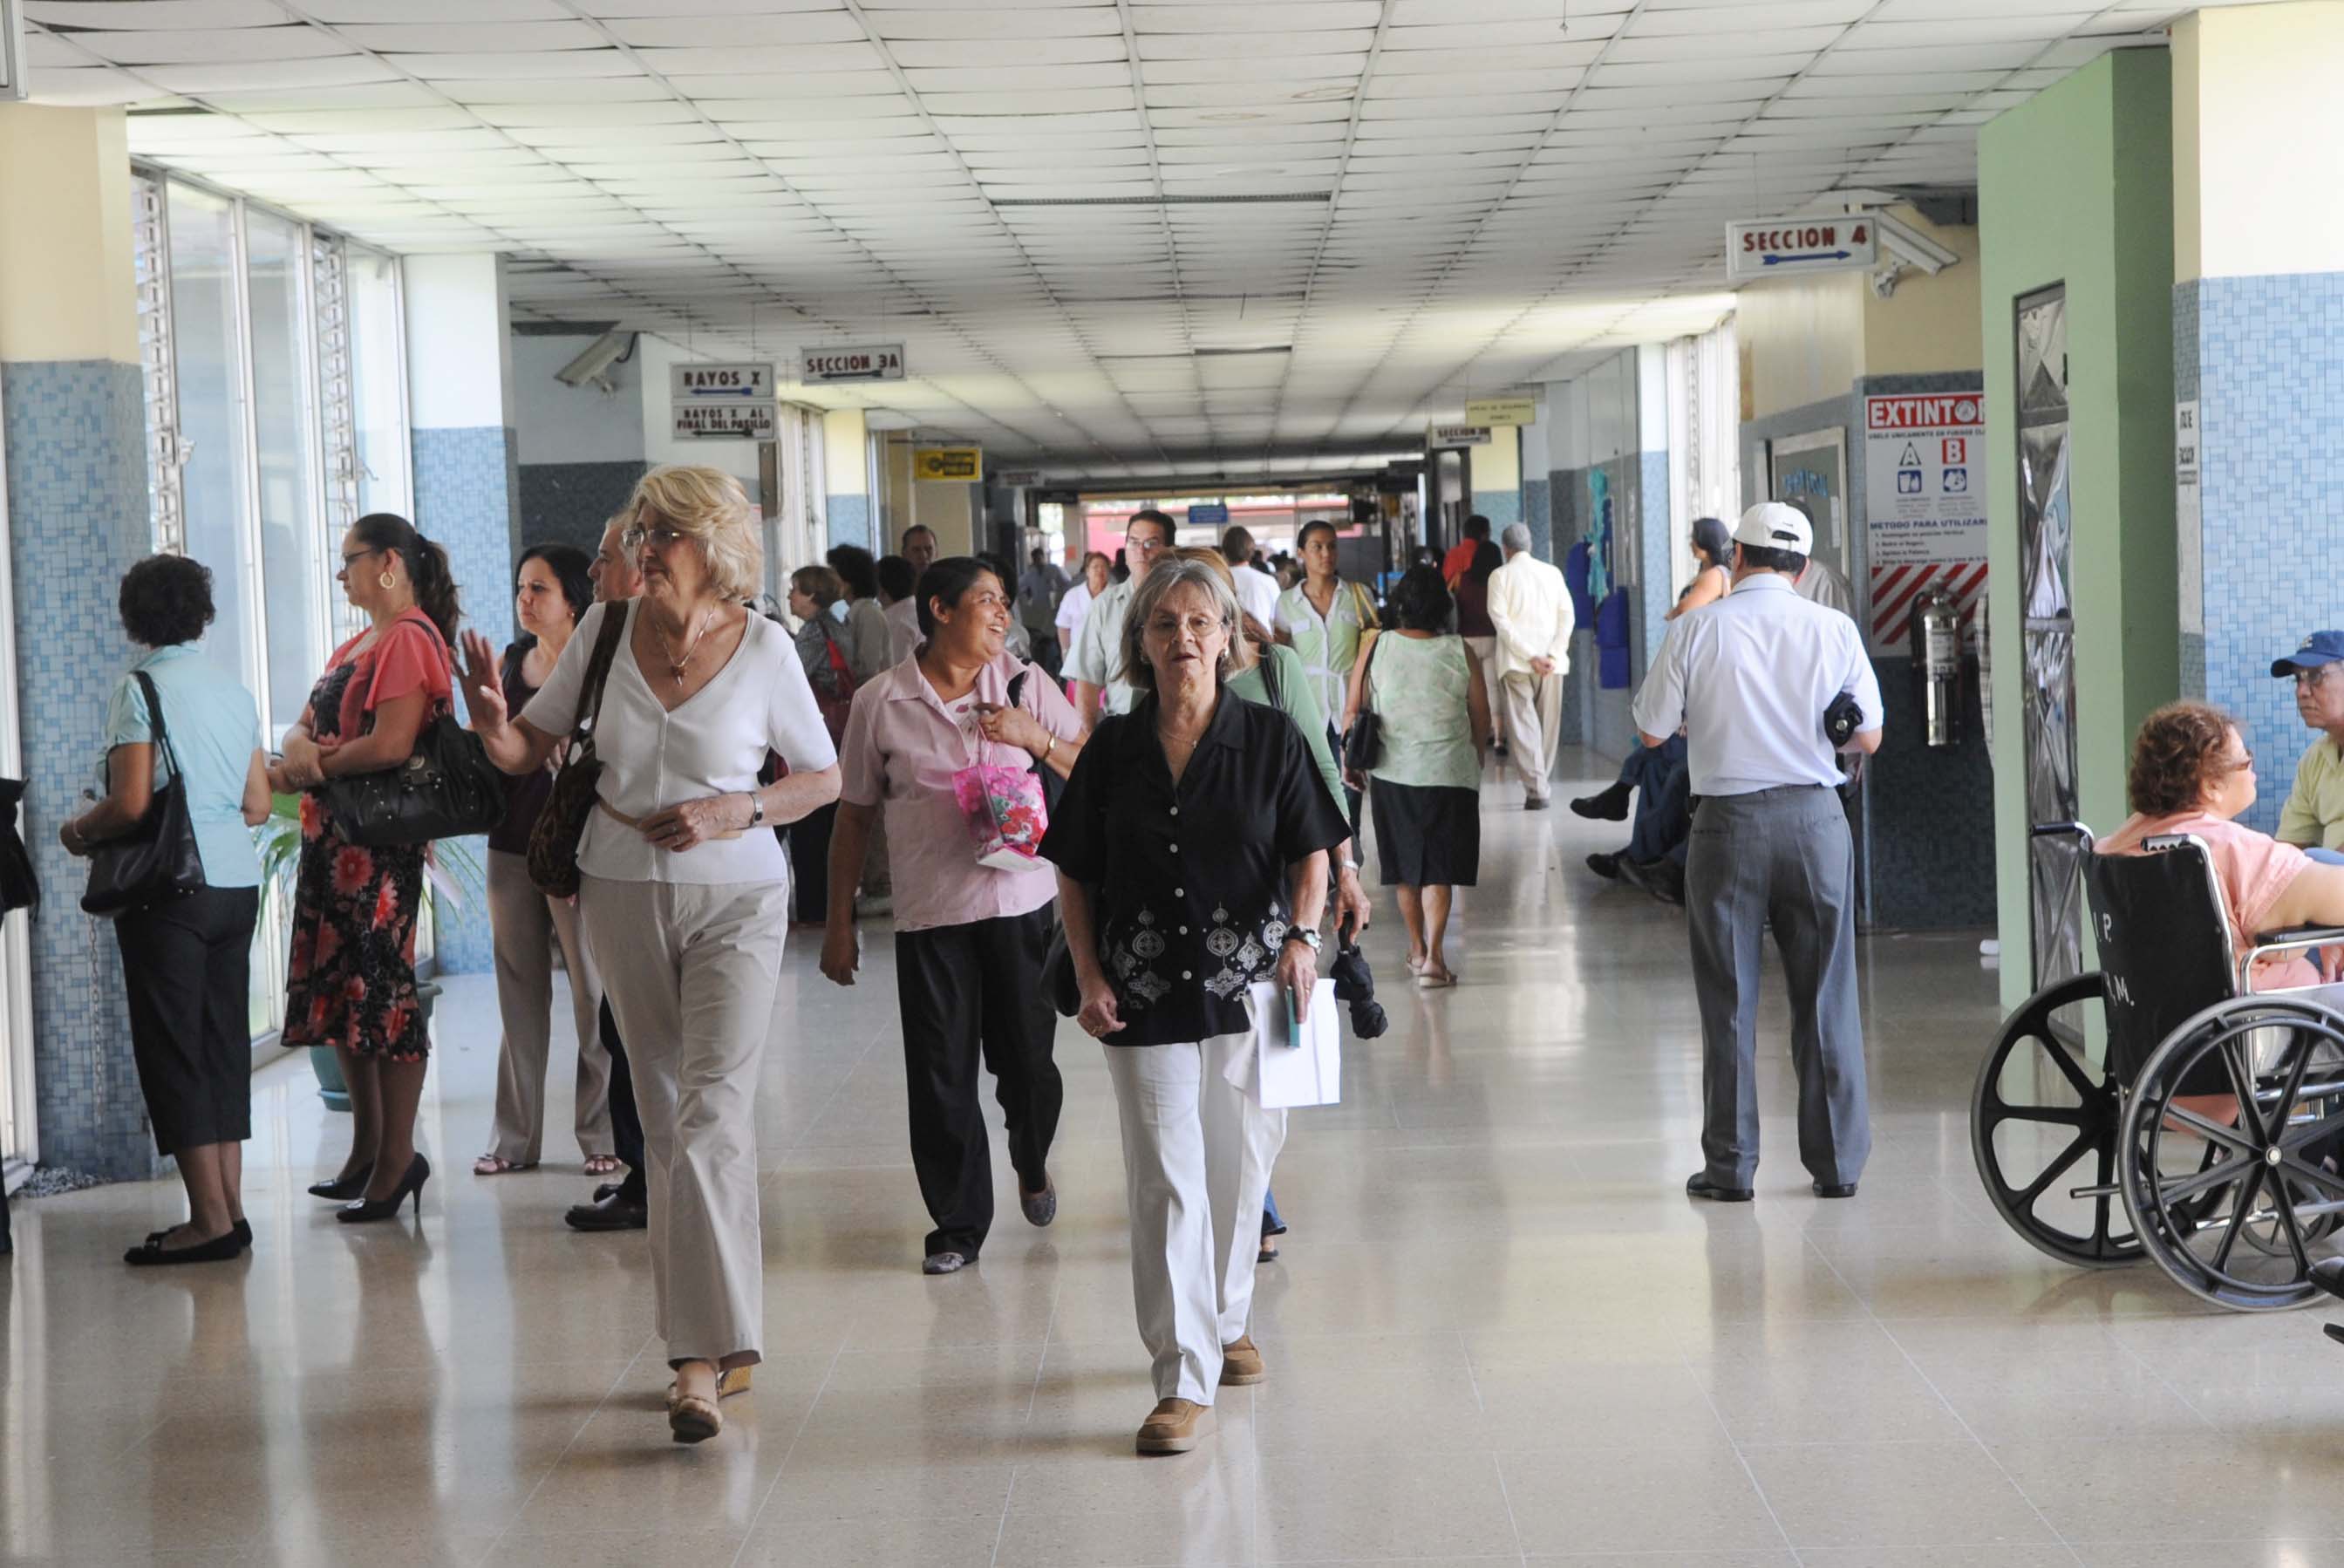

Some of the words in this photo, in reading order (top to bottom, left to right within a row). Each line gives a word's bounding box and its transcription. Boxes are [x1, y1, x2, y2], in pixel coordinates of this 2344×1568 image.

[1744, 227, 1836, 252] SECCION
[1851, 224, 1868, 245] 4
[807, 355, 870, 373] SECCION
[878, 353, 899, 369] 3A
[684, 371, 740, 386] RAYOS
[751, 371, 760, 385] X
[684, 408, 722, 419] RAYOS
[750, 407, 764, 418] AL
